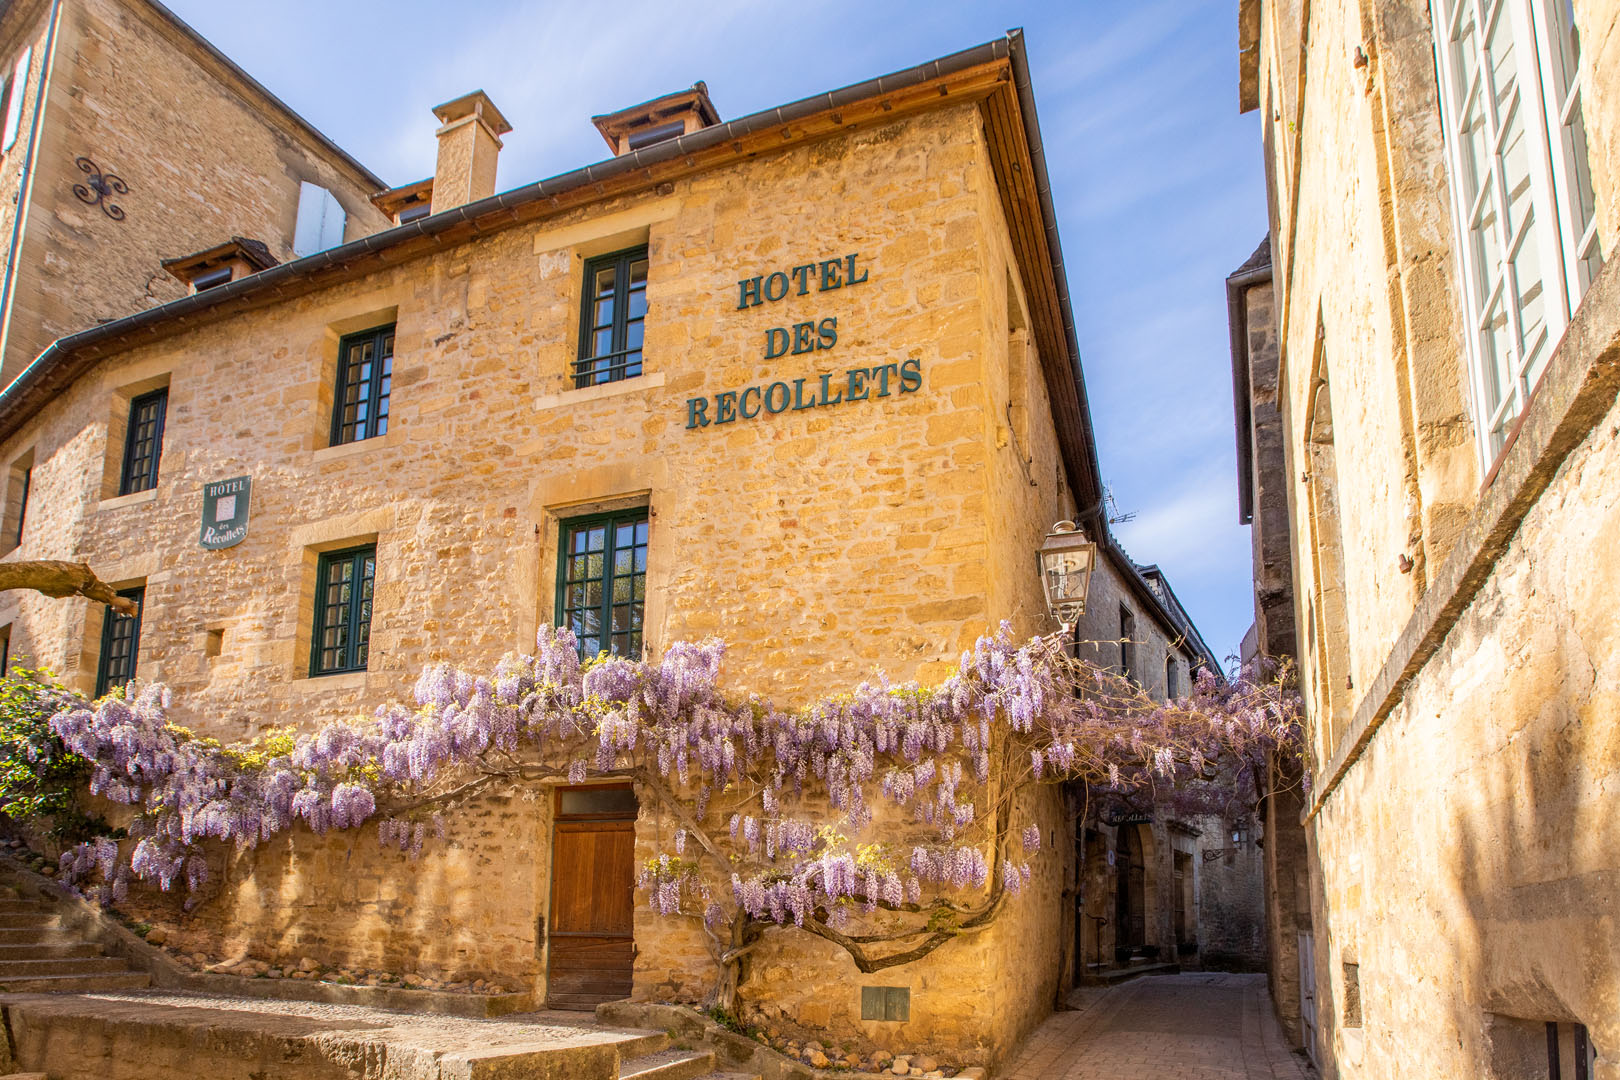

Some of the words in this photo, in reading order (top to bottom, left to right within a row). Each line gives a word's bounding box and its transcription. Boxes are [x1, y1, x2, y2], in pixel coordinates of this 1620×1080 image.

[737, 253, 868, 310] HOTEL
[764, 316, 837, 360] DES
[685, 359, 922, 429] RECOLLETS
